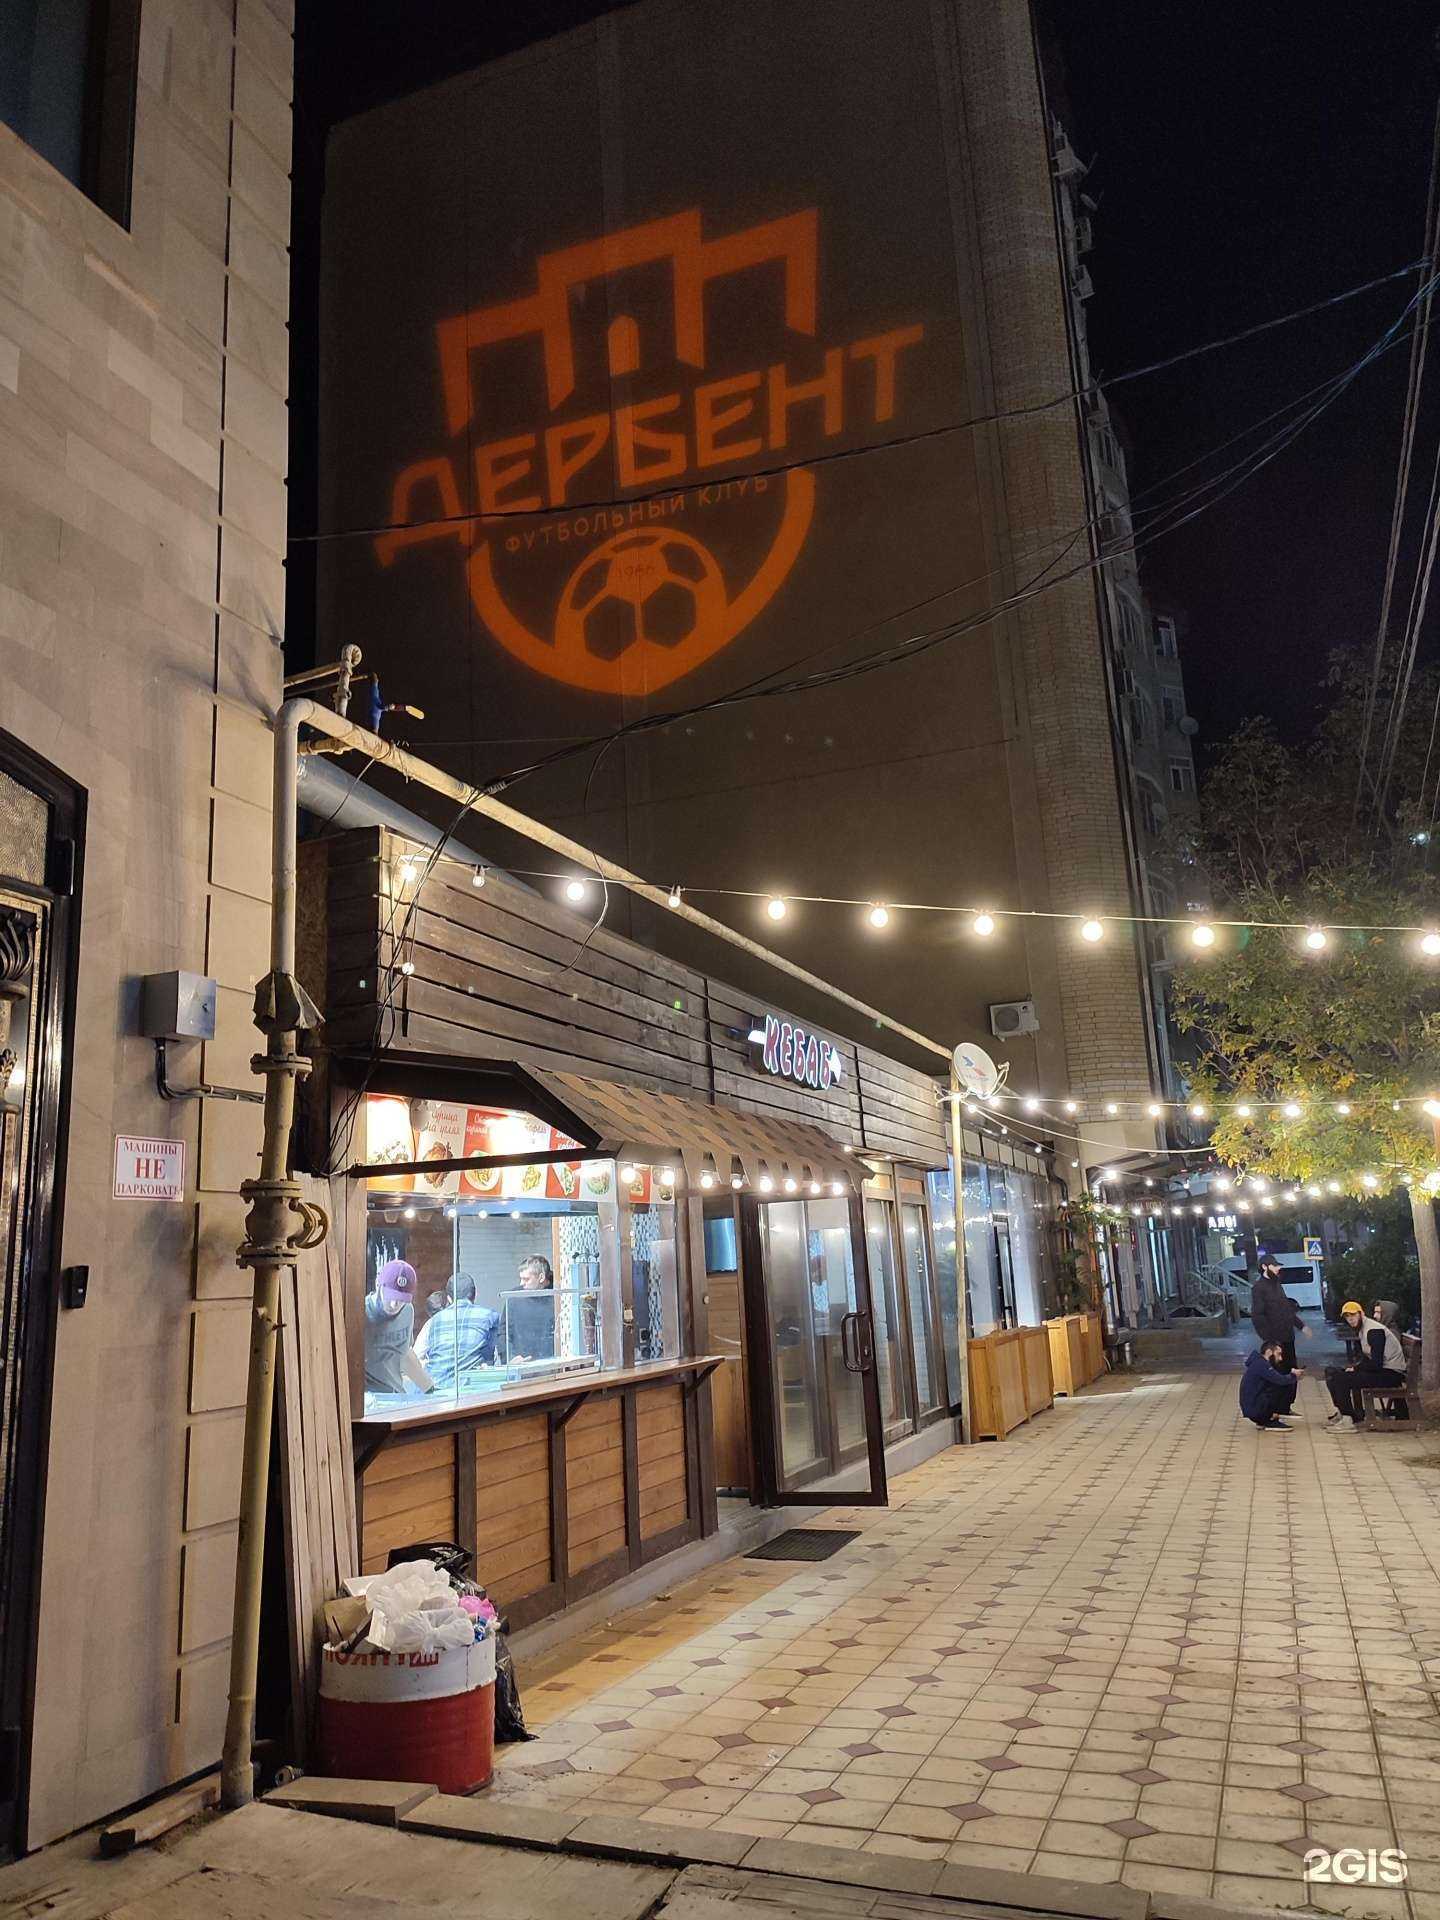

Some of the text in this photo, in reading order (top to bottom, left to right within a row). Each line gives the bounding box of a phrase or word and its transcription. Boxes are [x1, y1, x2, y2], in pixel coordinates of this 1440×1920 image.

[374, 323, 924, 569] ДЕРБЕНТ
[698, 475, 769, 506] КЛУБ
[124, 1141, 177, 1155] МАШИНЫ
[135, 1157, 166, 1180] НЕ
[117, 1183, 180, 1197] ПАРКОВАТЬ
